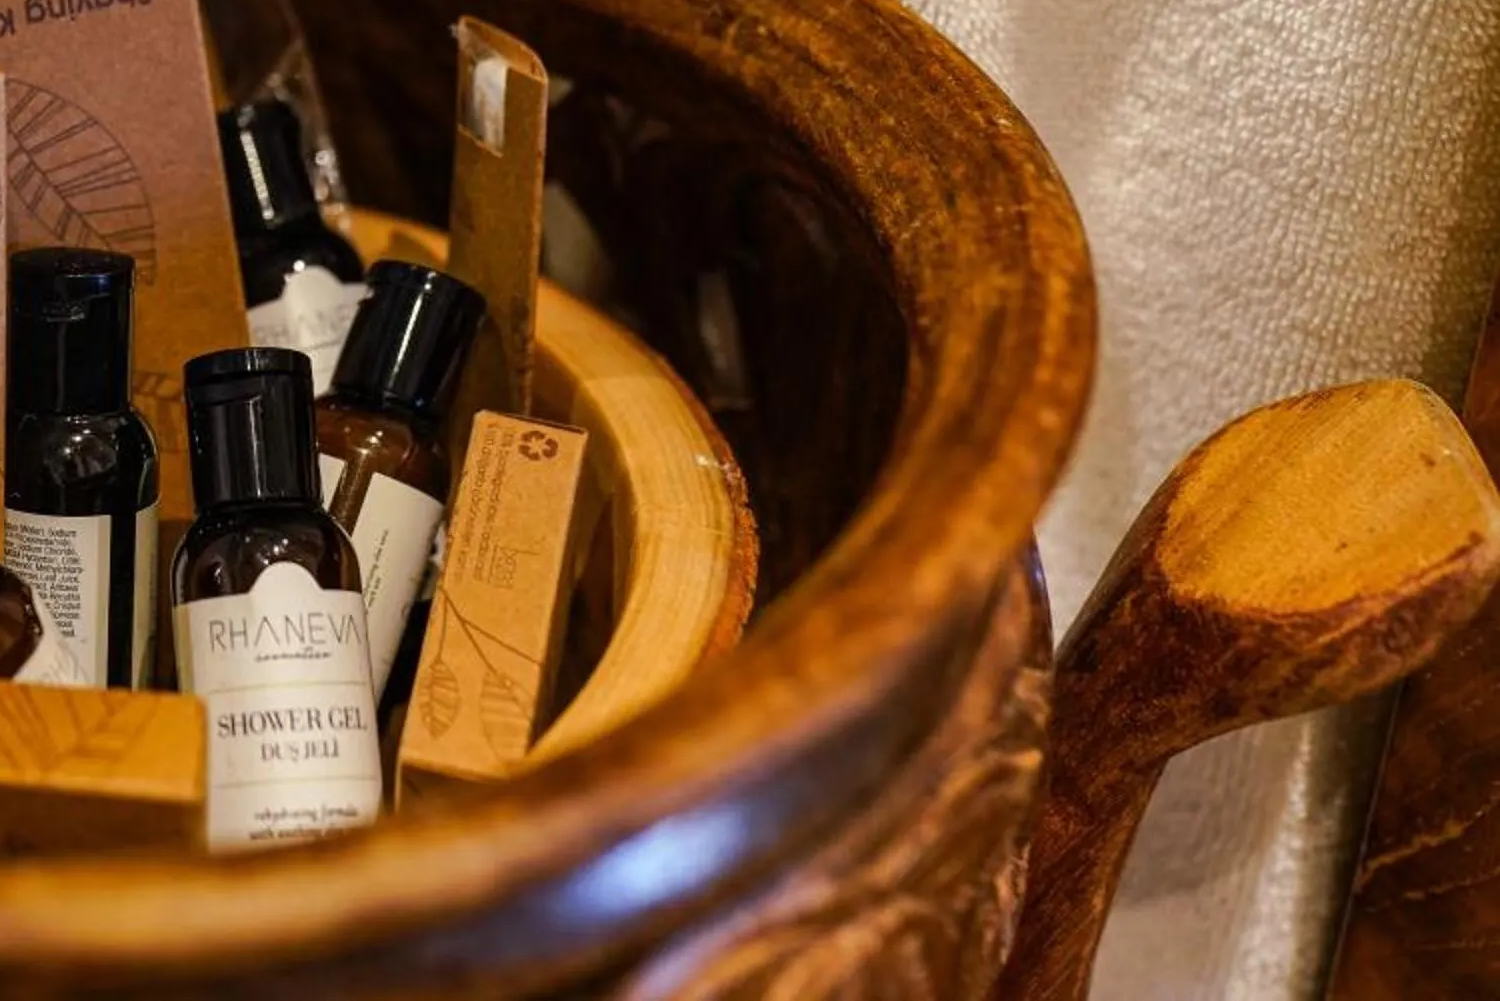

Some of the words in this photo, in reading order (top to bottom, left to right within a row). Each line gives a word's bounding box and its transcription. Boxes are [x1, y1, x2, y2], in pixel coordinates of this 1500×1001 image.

[209, 611, 364, 653] RHANEVA
[216, 706, 324, 740] SHOWER
[328, 705, 368, 732] GEL
